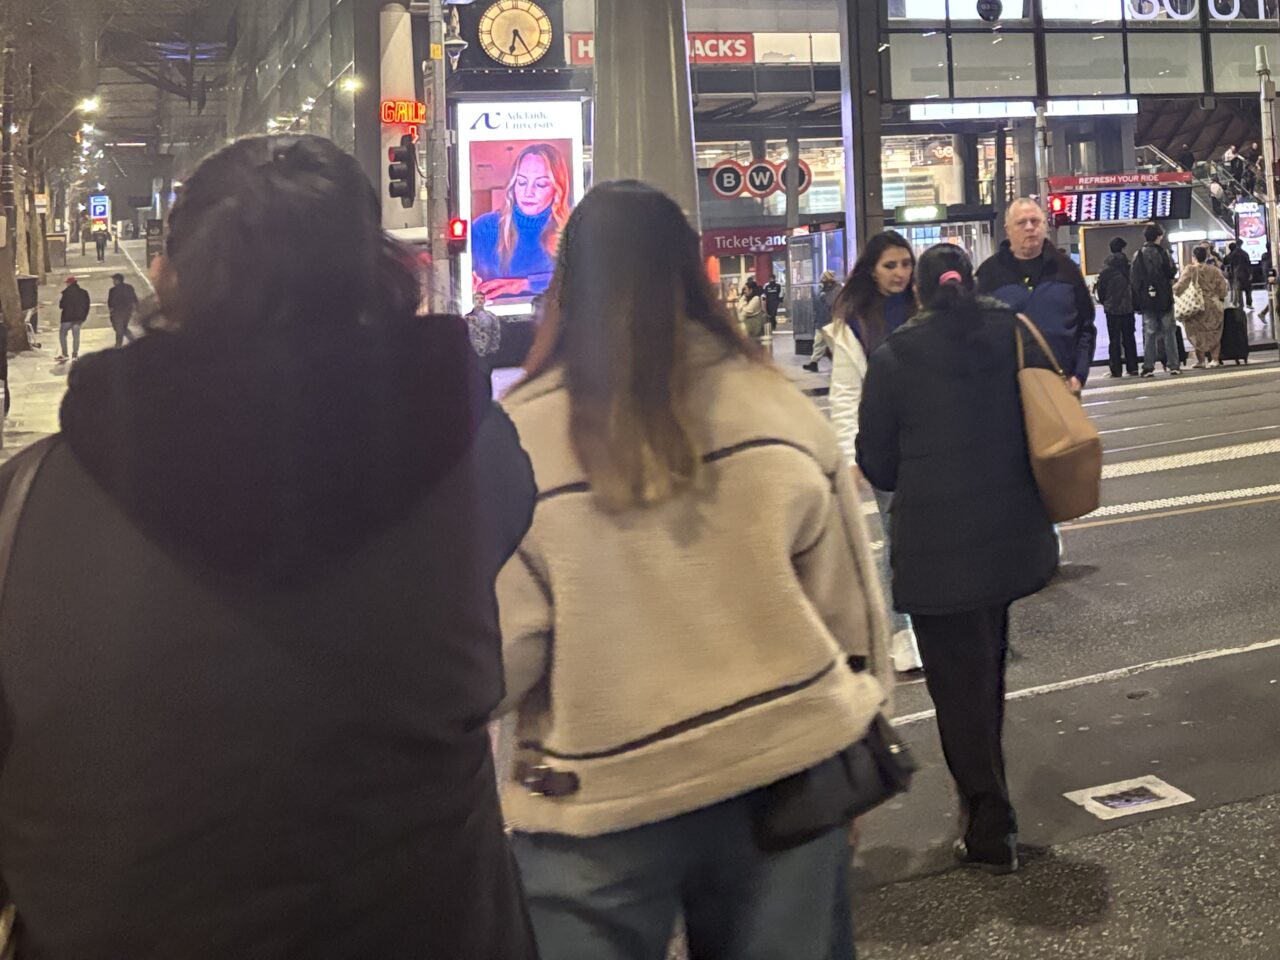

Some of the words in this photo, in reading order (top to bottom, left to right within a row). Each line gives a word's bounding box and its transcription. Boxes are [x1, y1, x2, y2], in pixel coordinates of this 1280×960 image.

[723, 173, 735, 187] B
[752, 171, 770, 186] W
[1078, 175, 1116, 185] REFRESH
[1117, 174, 1139, 183] YOUR
[1140, 174, 1159, 182] RIDE
[714, 234, 762, 249] Tickets
